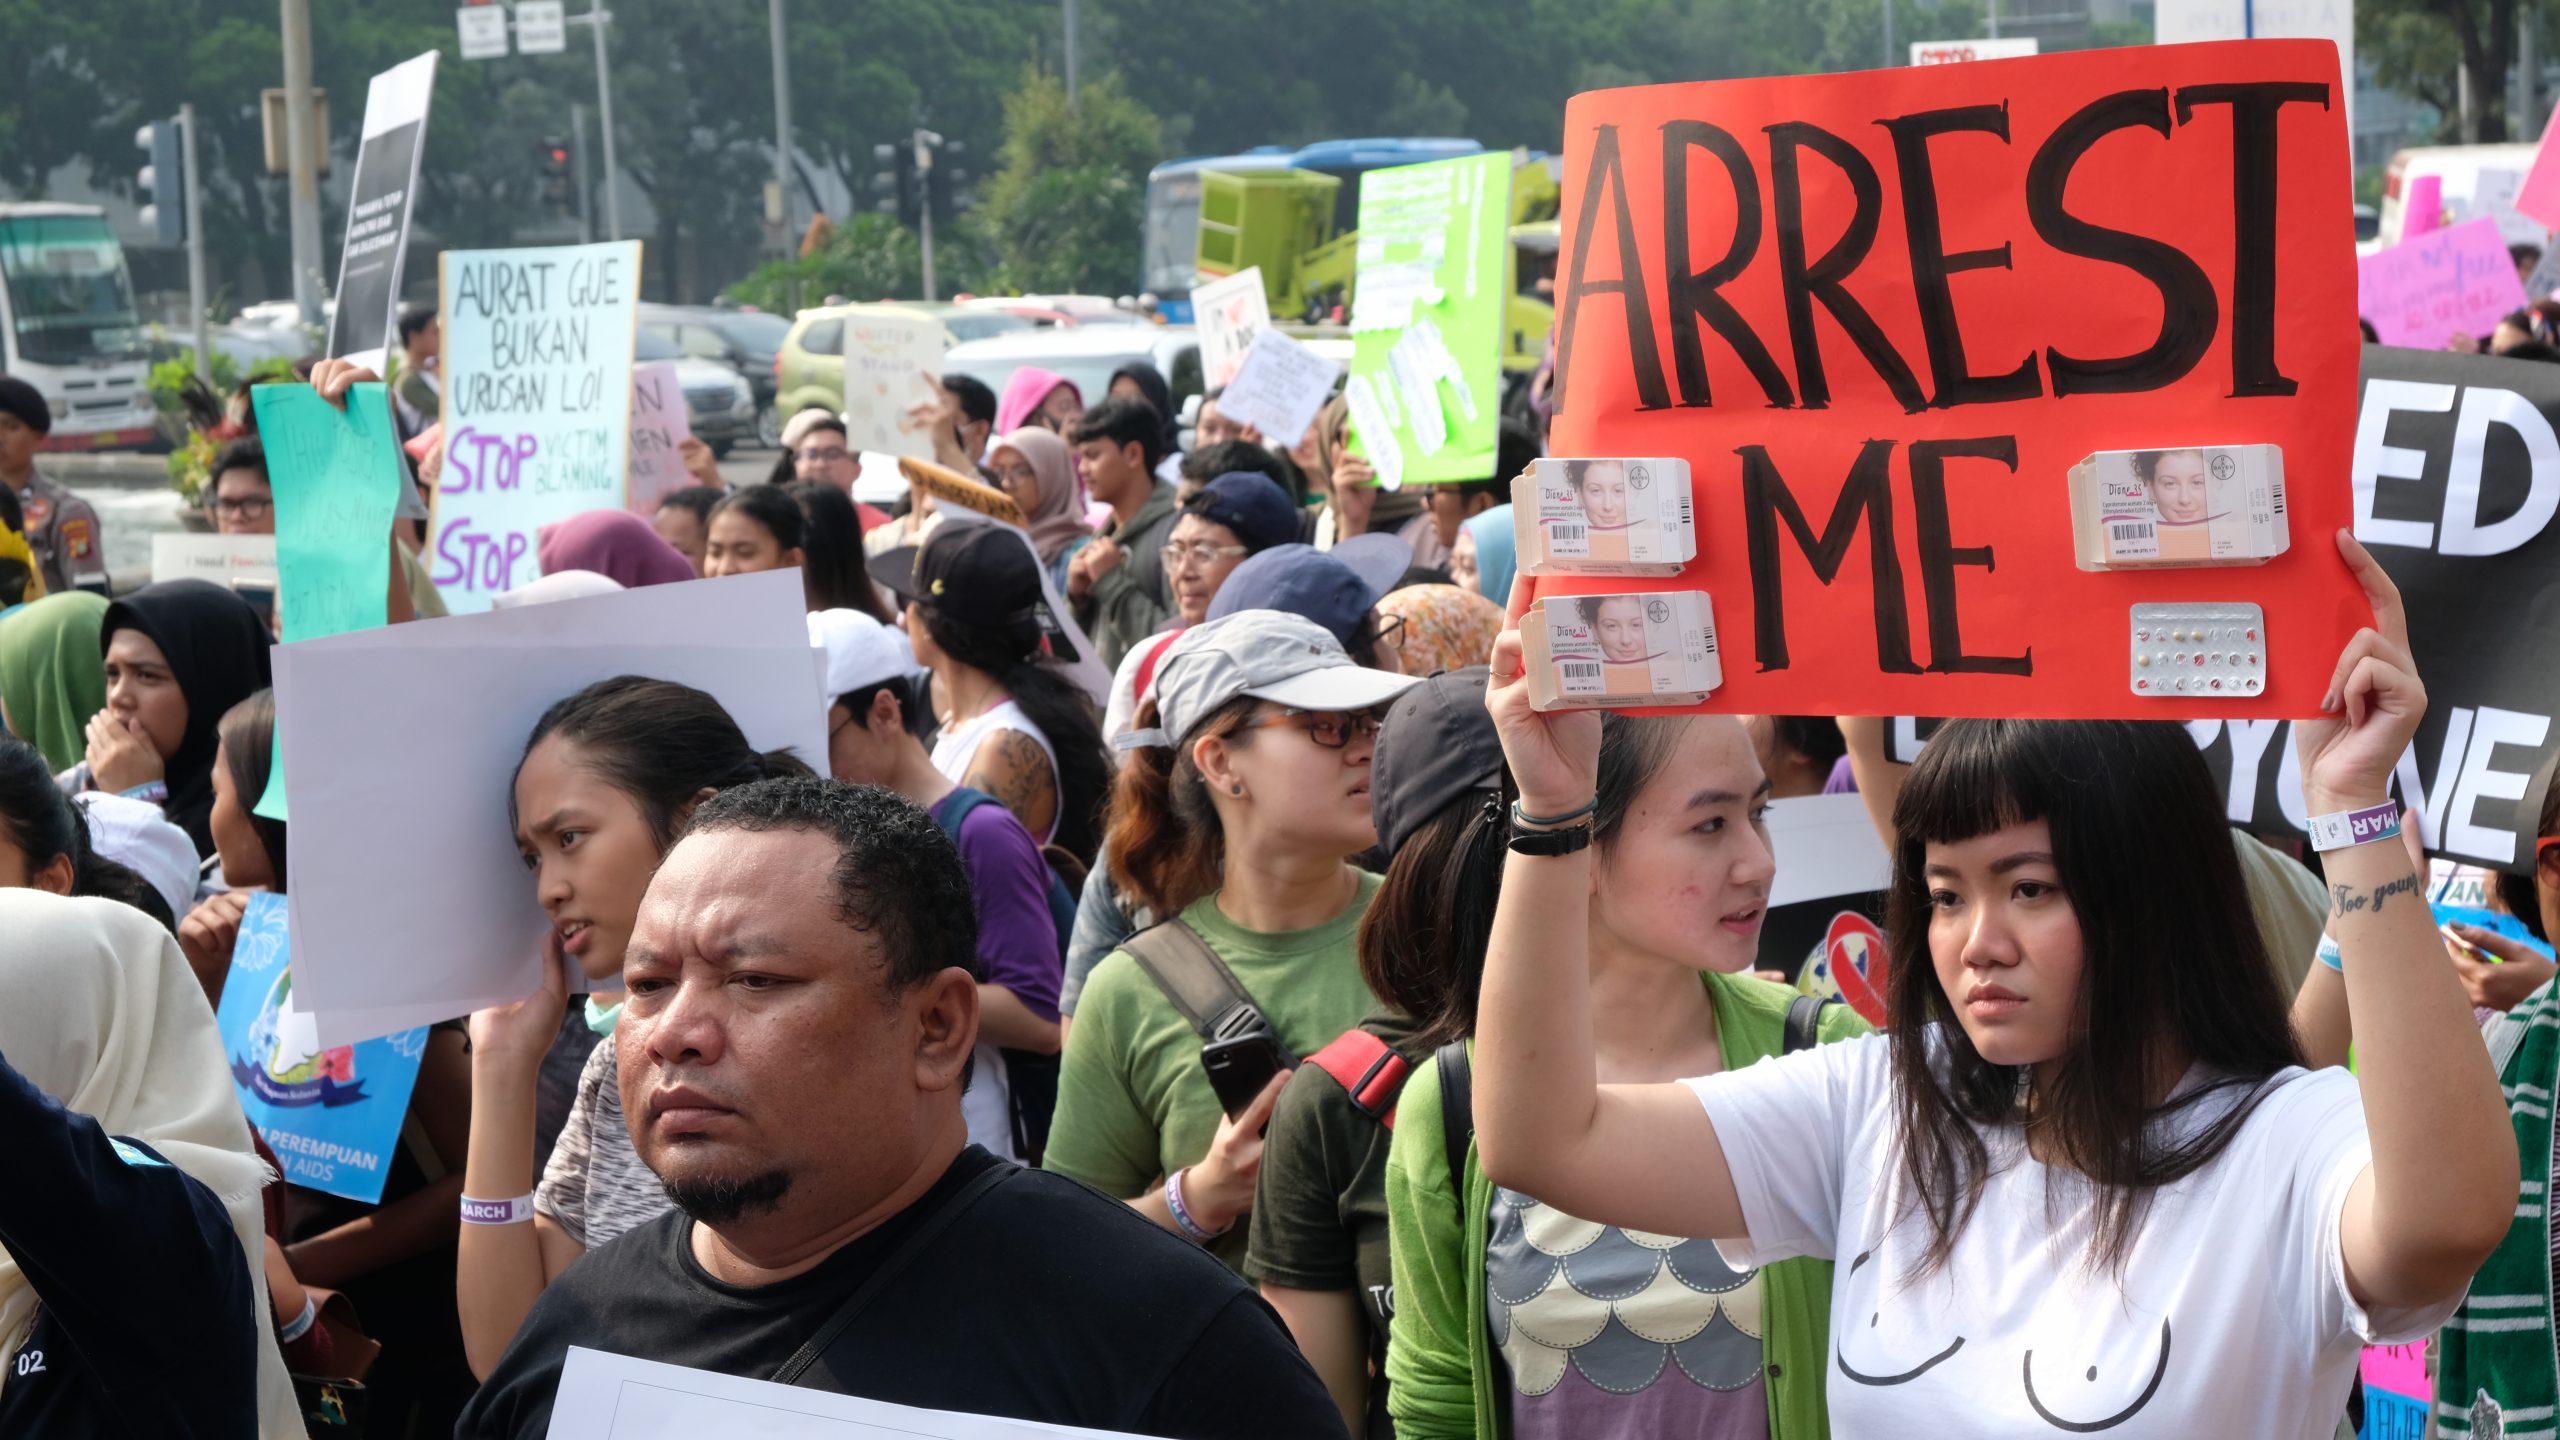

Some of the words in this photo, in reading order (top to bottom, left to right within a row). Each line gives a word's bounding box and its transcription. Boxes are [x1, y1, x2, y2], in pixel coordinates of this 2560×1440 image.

[1553, 82, 2330, 416] ARREST
[454, 261, 556, 317] AURAT
[567, 258, 620, 308] GUE
[491, 316, 588, 371] BUKAN
[454, 371, 547, 416] URUSAN
[561, 367, 604, 412] LO!
[439, 426, 537, 494] STOP
[545, 428, 608, 458] VICTIM
[535, 459, 613, 495] BLAMING
[2352, 378, 2560, 557] ED
[432, 518, 528, 592] STOP
[1733, 434, 2033, 678] ME
[2333, 882, 2368, 918] Too
[268, 1129, 379, 1172] PEREMPUAN
[294, 1157, 335, 1182] AIDS
[461, 1203, 506, 1219] MARCH
[18, 1350, 47, 1376] 02
